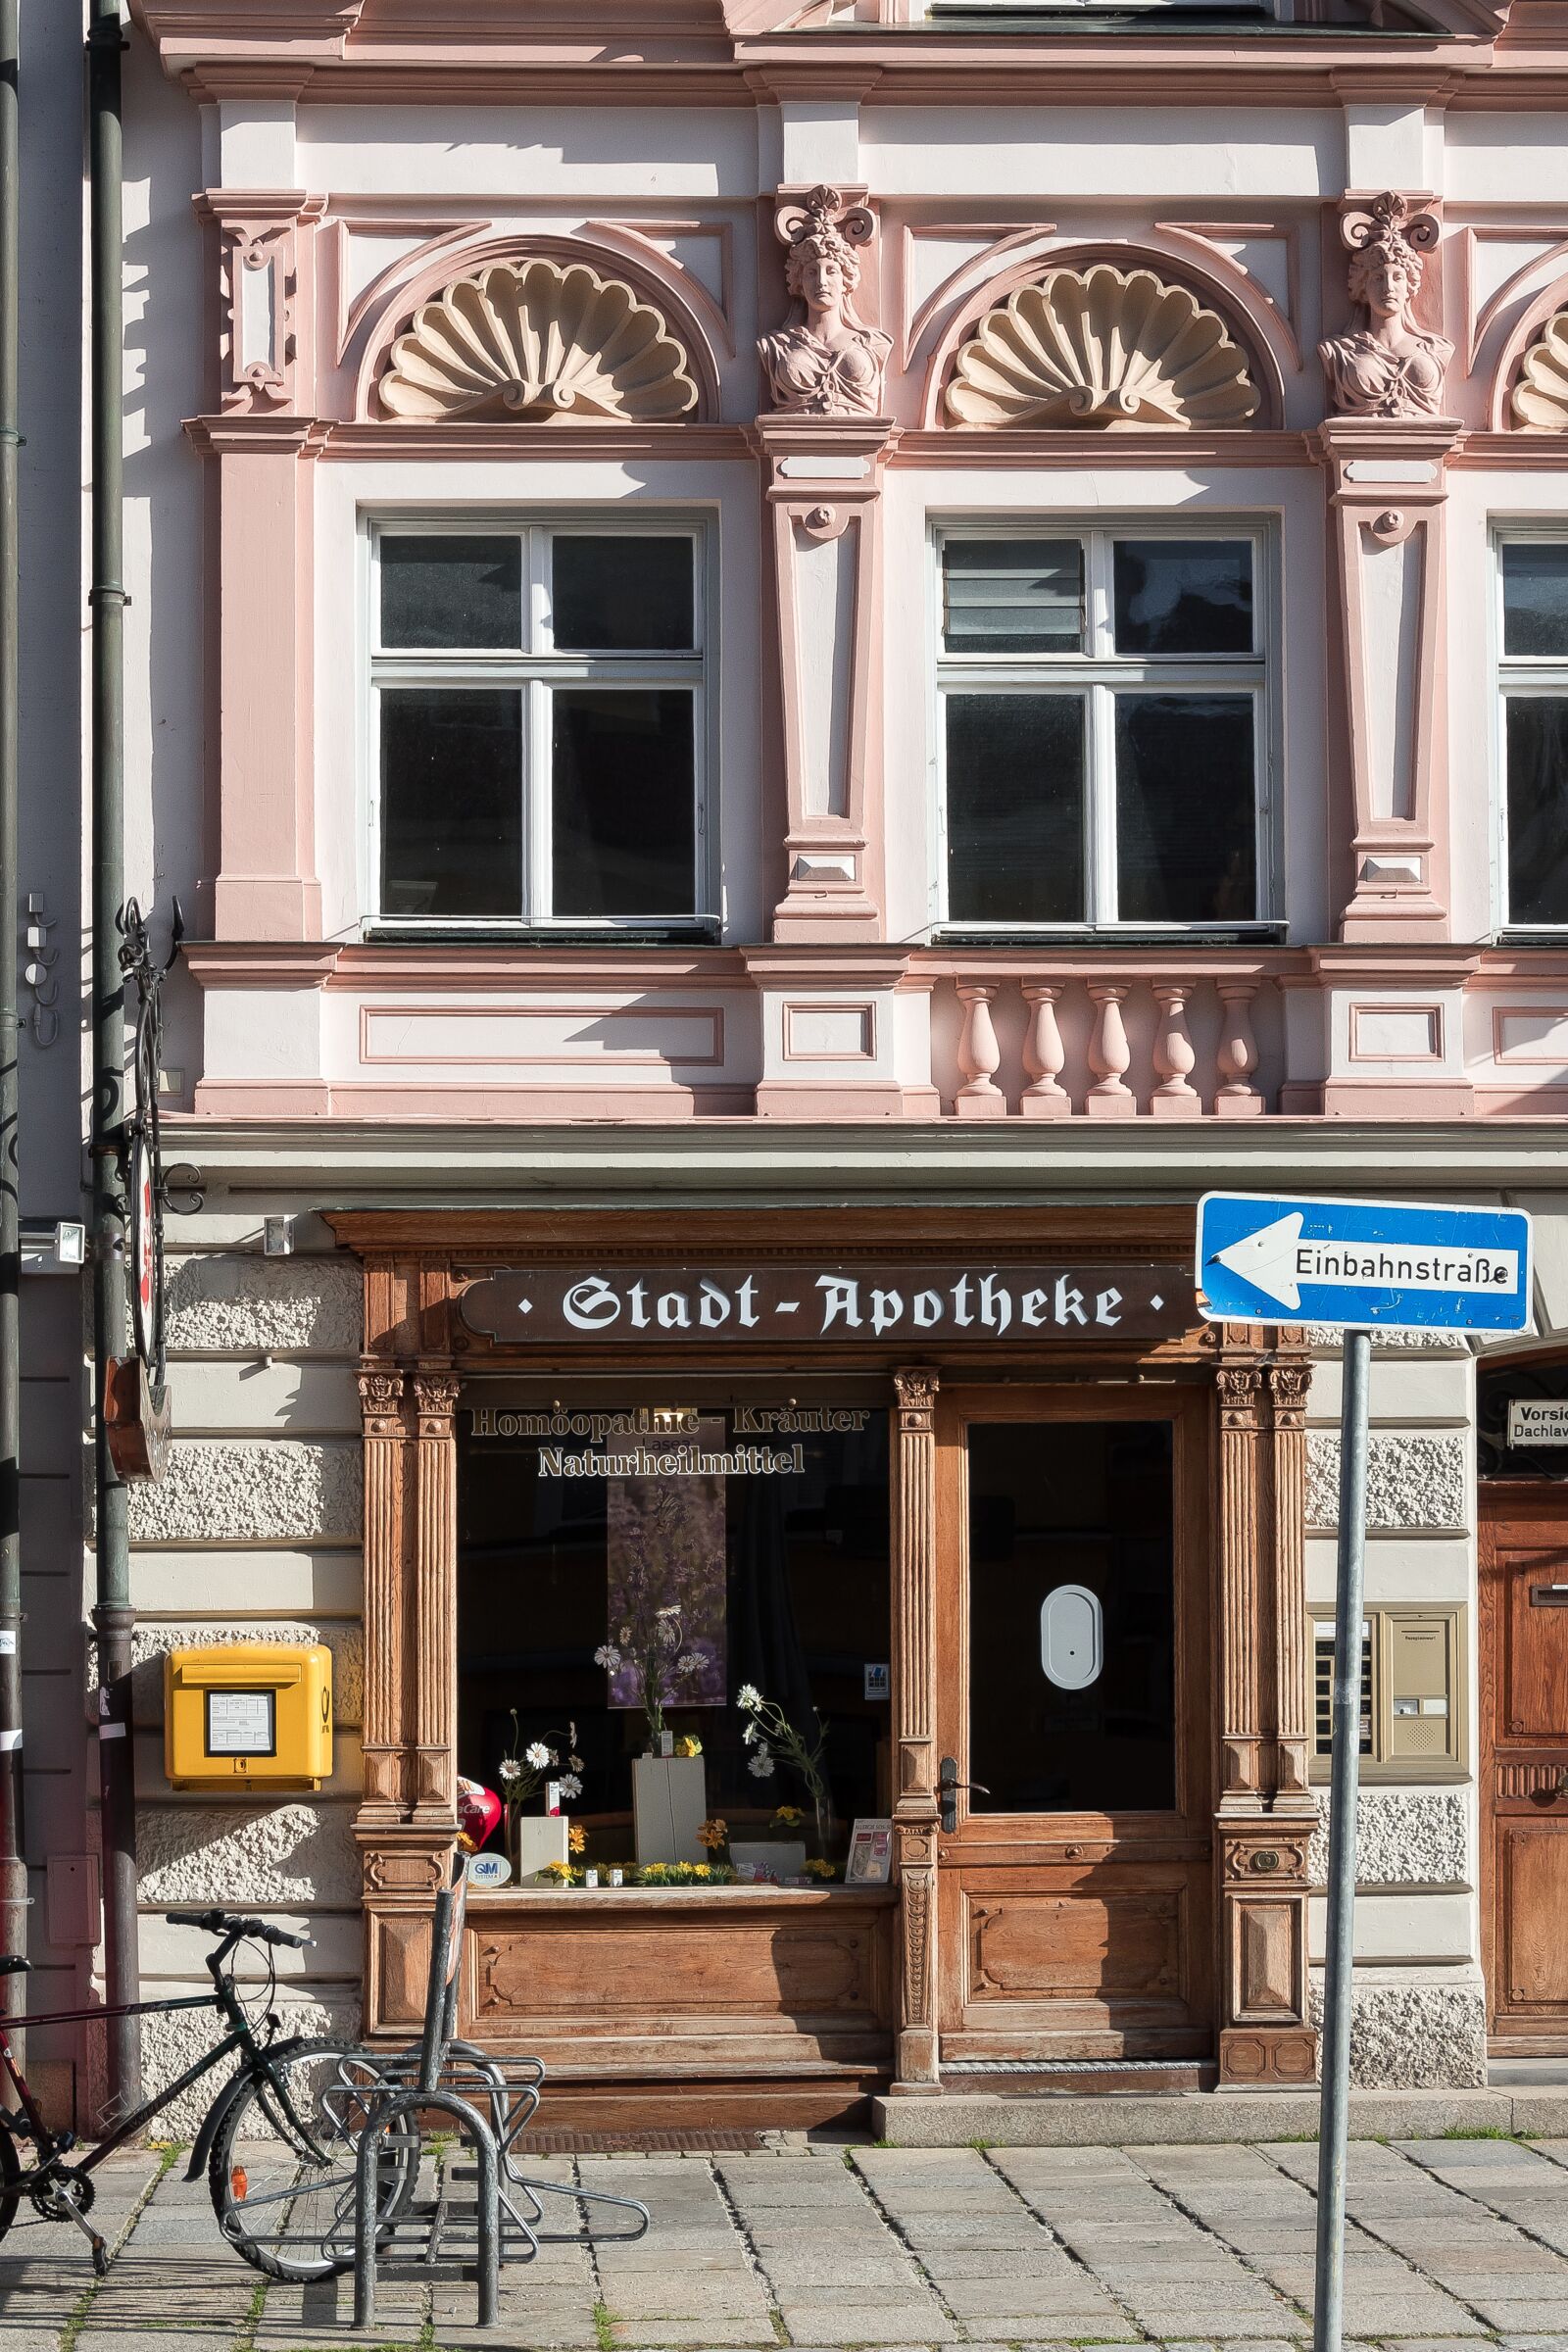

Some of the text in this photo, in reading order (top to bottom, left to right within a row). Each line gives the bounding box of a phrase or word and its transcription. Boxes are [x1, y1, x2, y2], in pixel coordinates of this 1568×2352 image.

[1296, 1249, 1508, 1285] Einbahnstraße
[563, 1274, 760, 1330] Stadt
[814, 1273, 1123, 1337] Apotheke
[470, 1407, 700, 1444] Homöopathie
[733, 1405, 870, 1434] Kräuter
[538, 1444, 806, 1478] Naturheilmittel
[457, 1803, 491, 1814] aCare
[475, 1863, 498, 1874] QM
